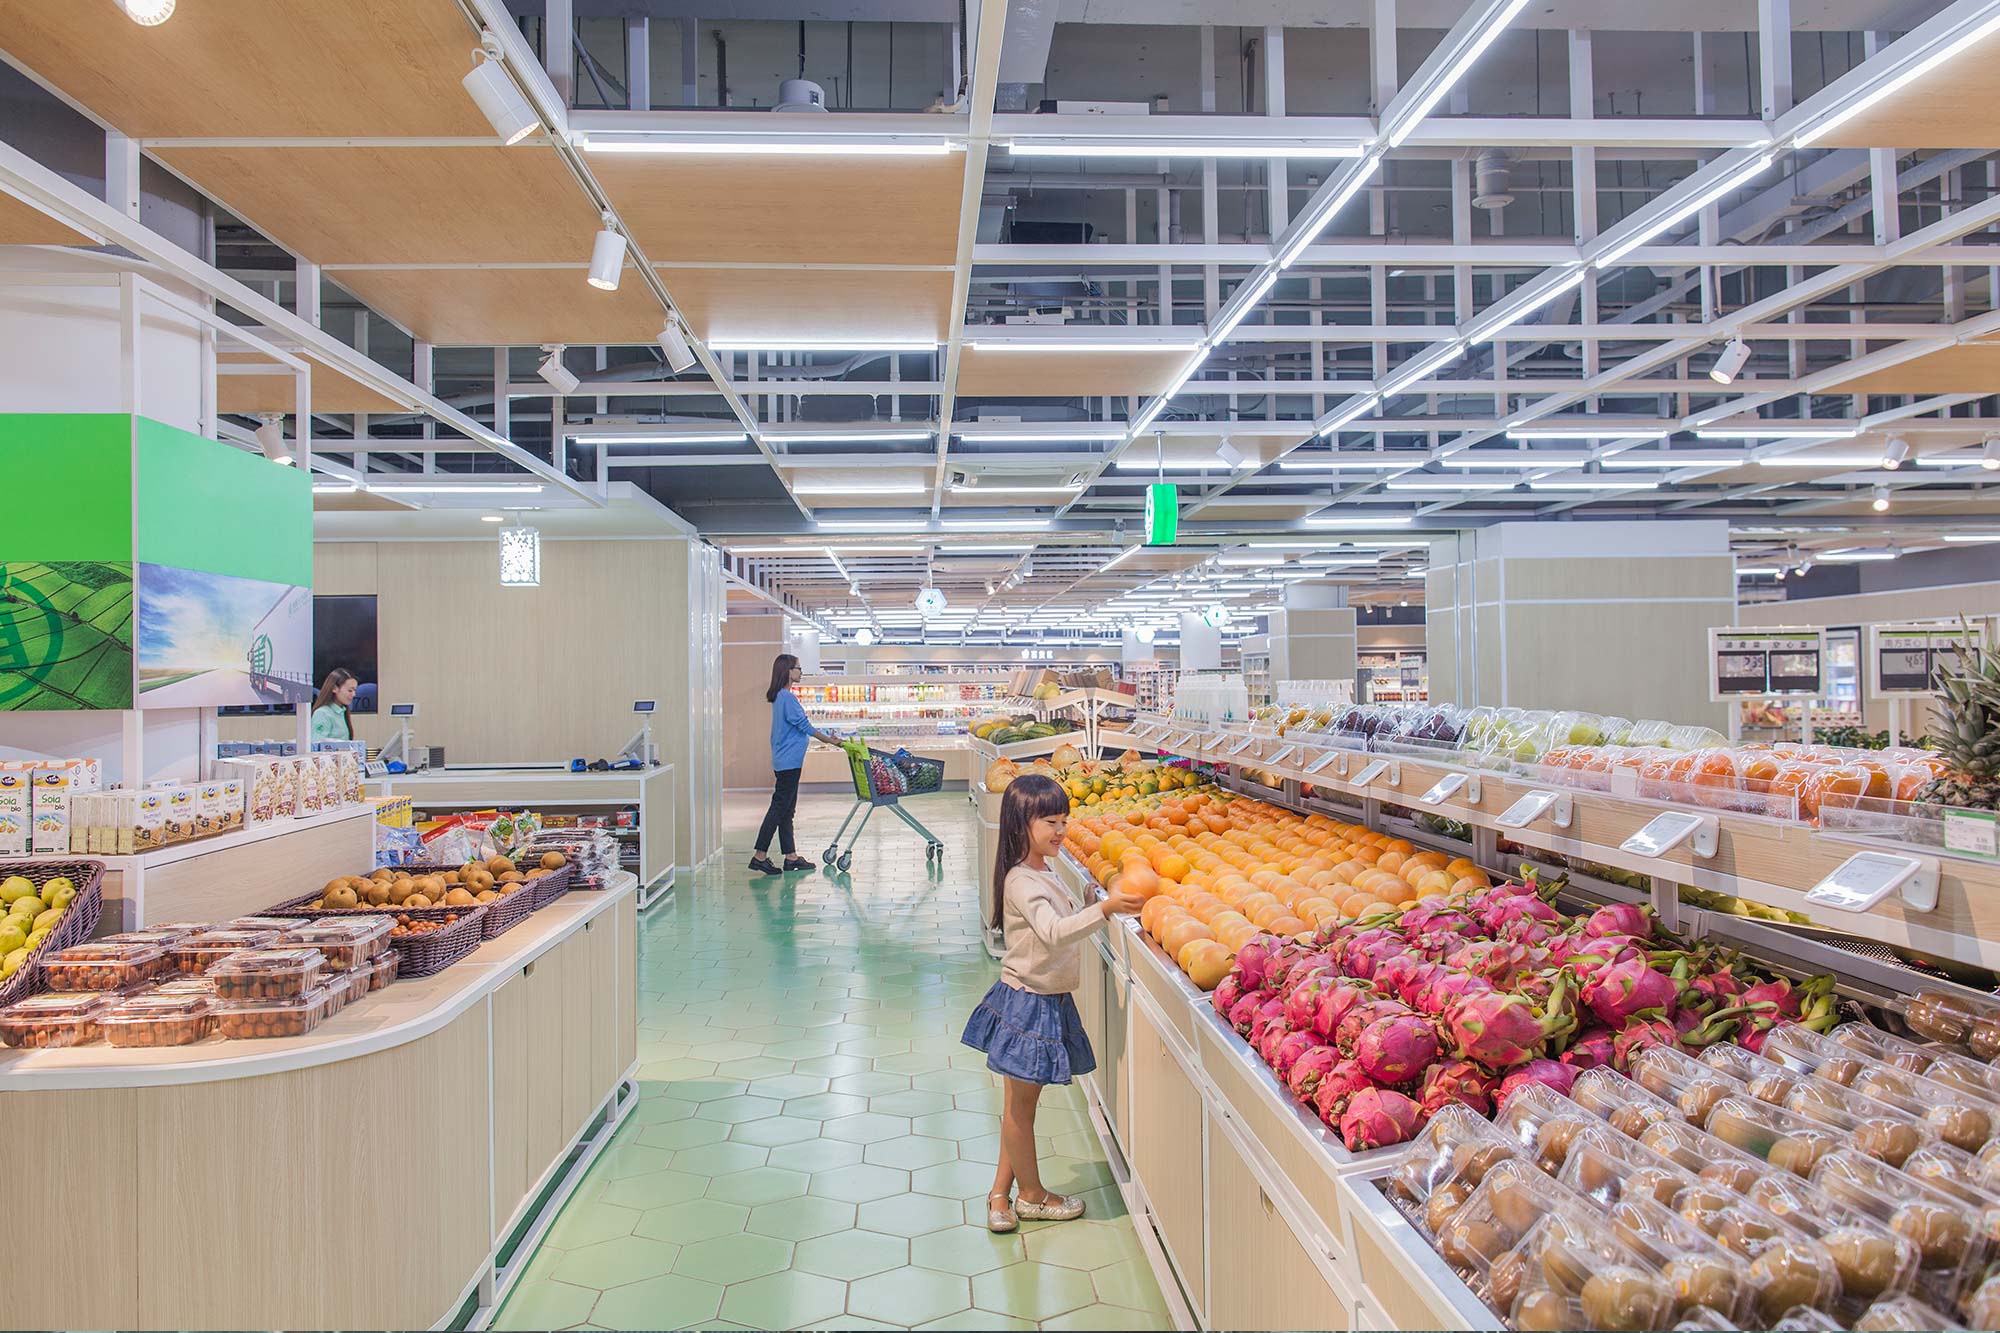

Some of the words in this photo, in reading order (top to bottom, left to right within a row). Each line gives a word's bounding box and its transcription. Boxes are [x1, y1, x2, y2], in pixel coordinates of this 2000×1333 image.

[1884, 639, 1921, 648] 南方菜心
[41, 793, 61, 804] Soia
